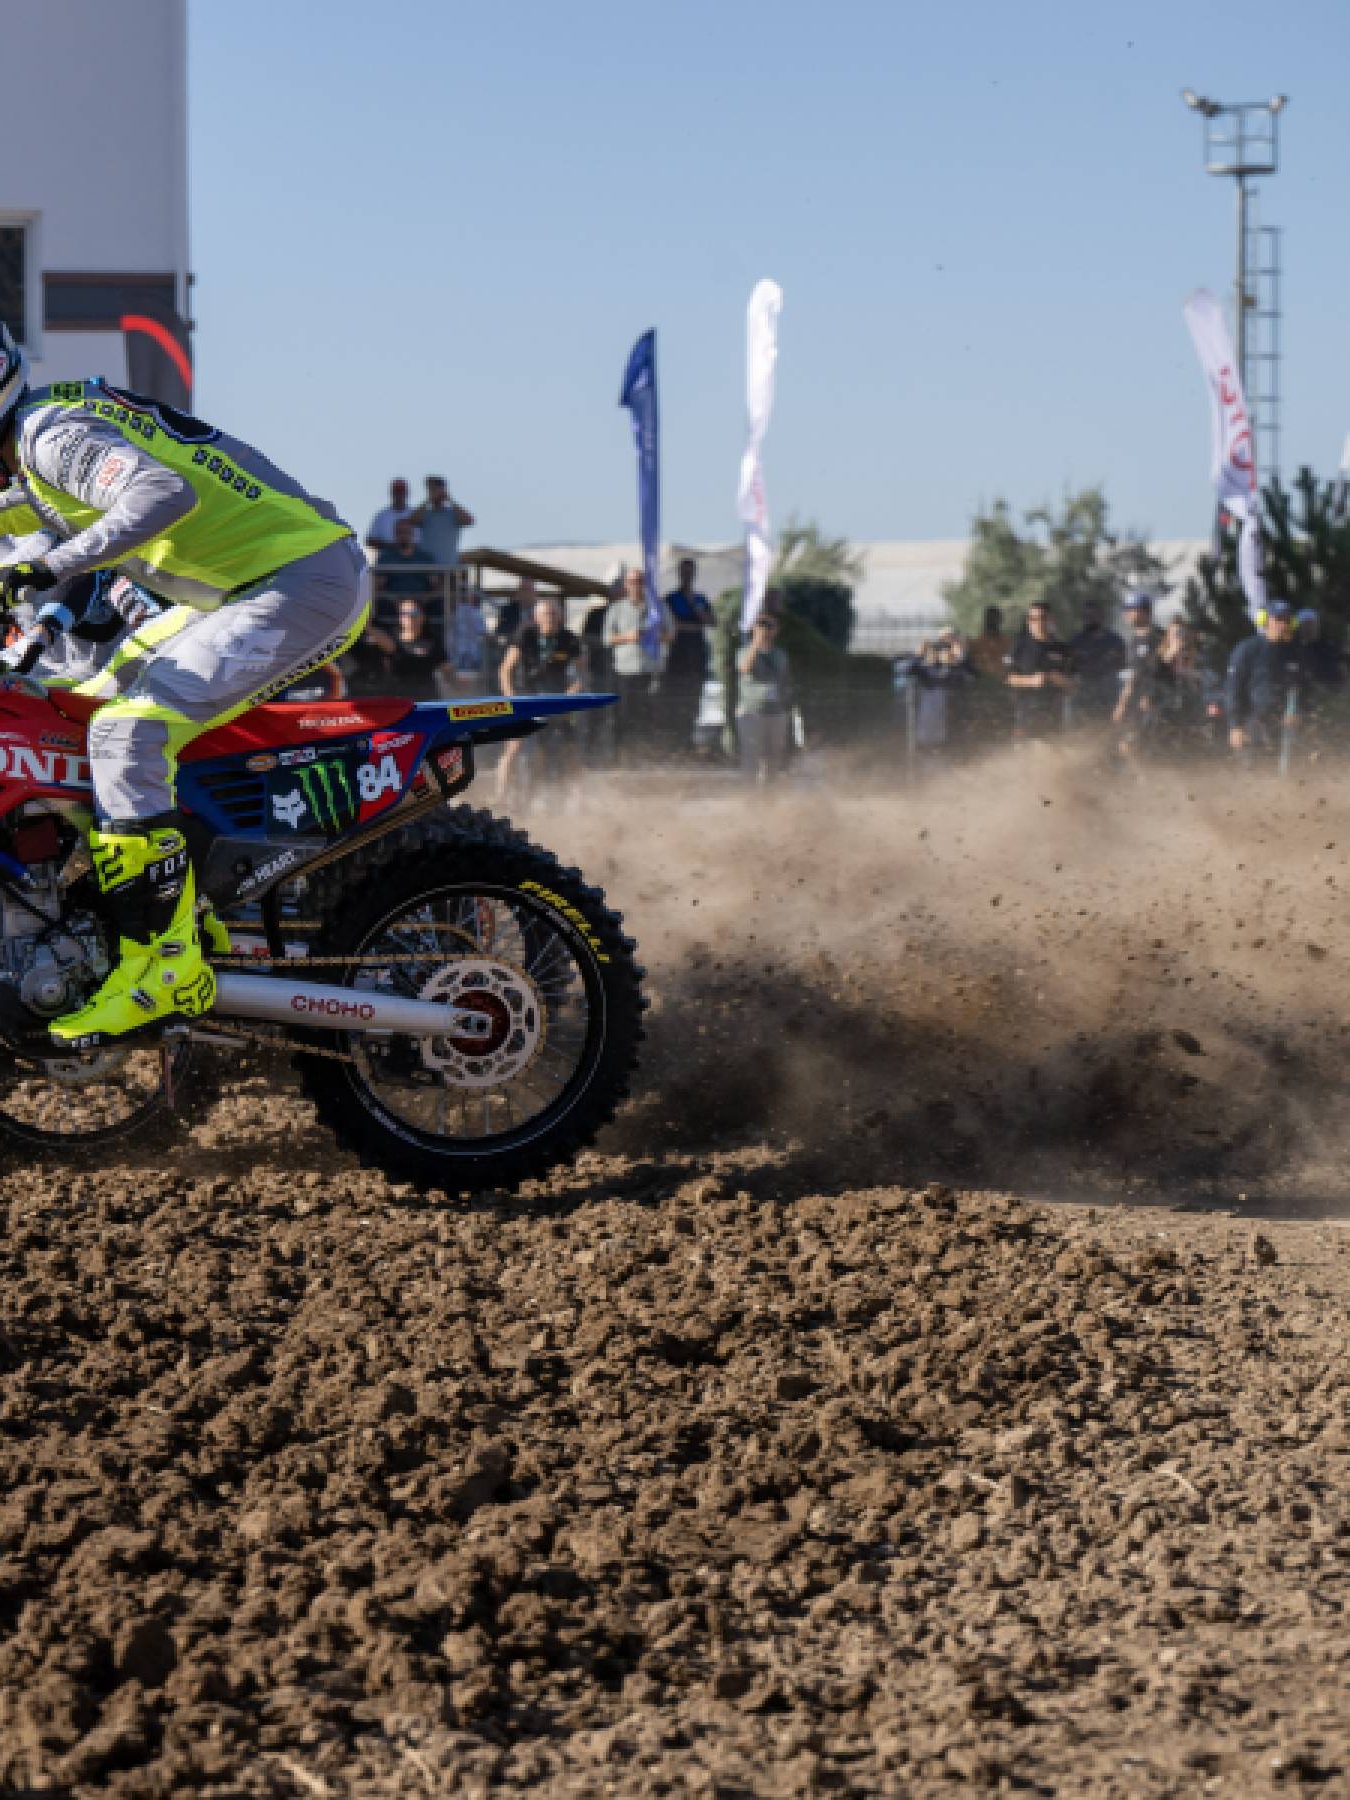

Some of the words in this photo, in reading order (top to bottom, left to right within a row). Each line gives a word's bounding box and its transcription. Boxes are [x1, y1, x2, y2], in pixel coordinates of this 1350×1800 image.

[356, 754, 403, 801] 84
[148, 852, 188, 882] FOX
[290, 994, 376, 1021] CHOHO
